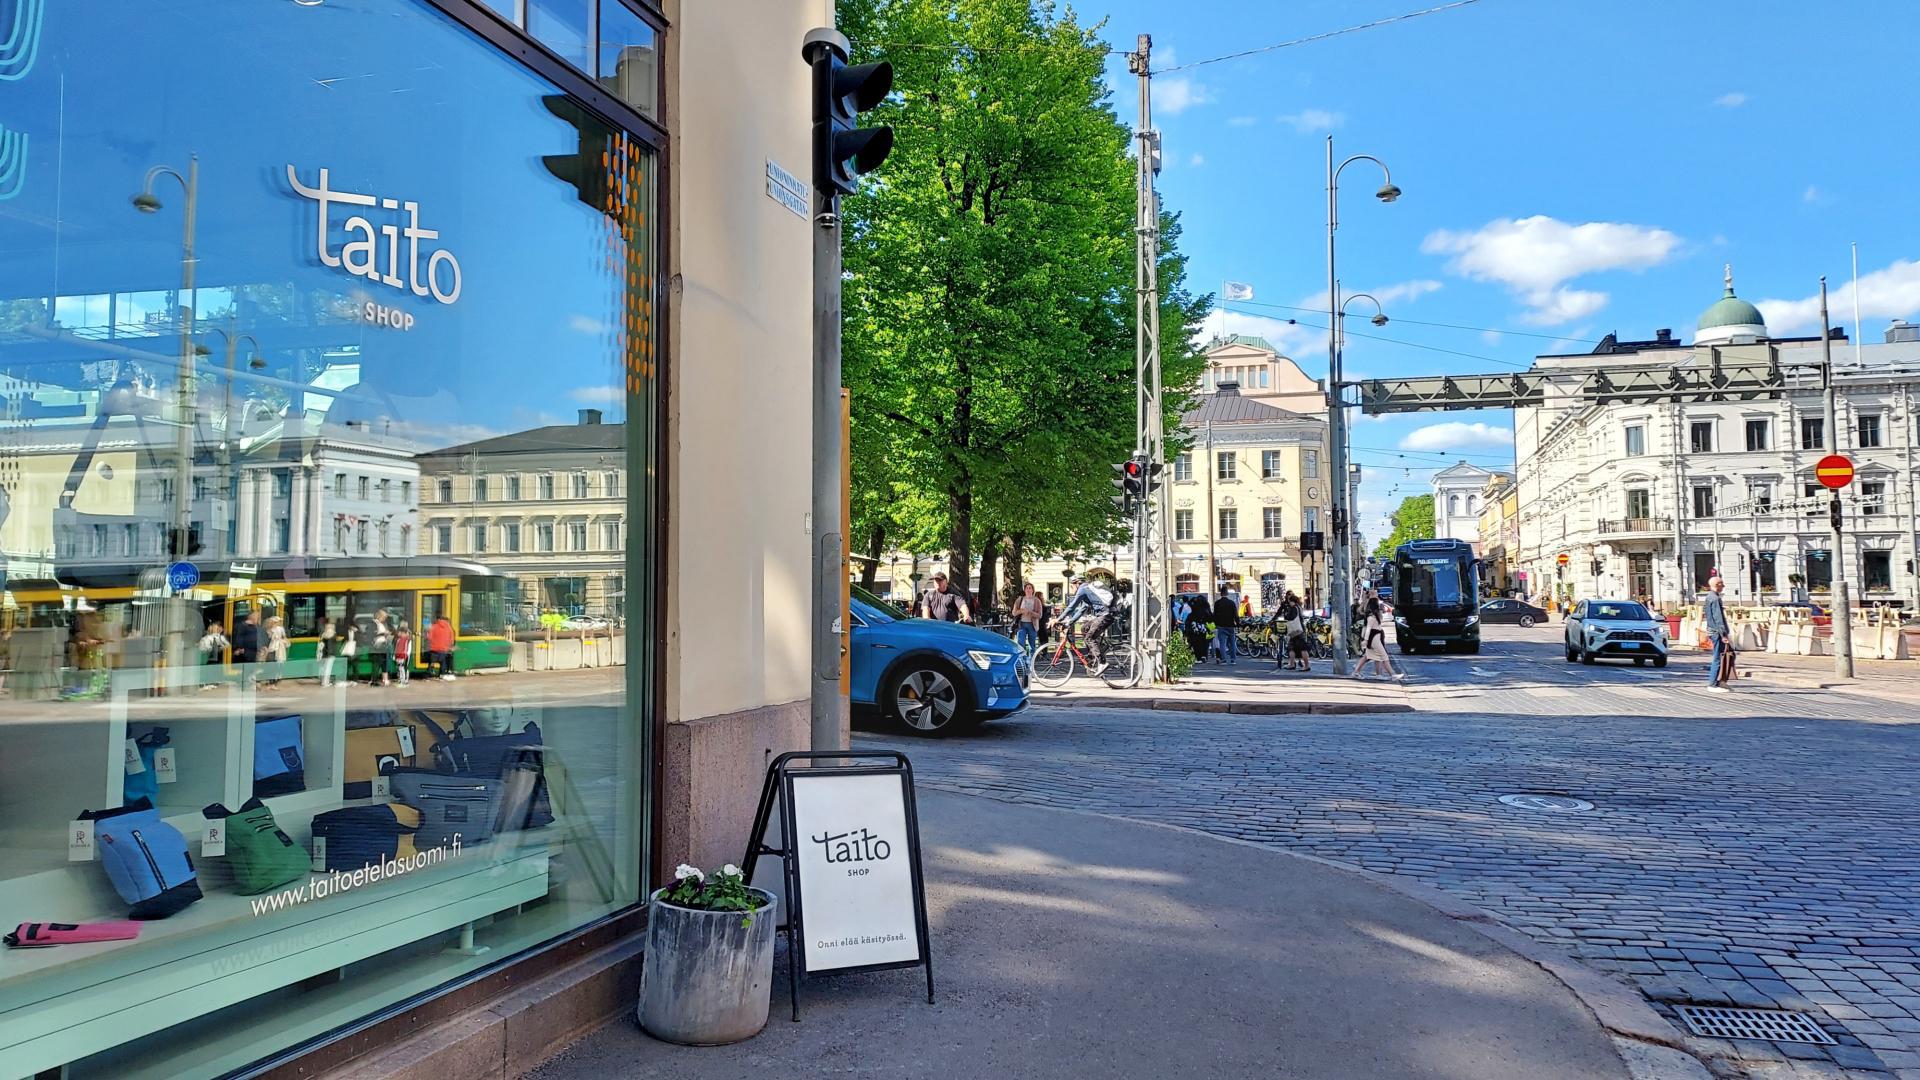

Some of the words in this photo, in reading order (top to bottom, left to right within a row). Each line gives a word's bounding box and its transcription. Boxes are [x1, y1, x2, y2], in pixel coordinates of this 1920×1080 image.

[287, 164, 462, 304] taito
[365, 301, 414, 331] SHOP
[812, 828, 891, 863] taito
[847, 868, 870, 877] SHOP
[817, 939, 838, 949] Onni
